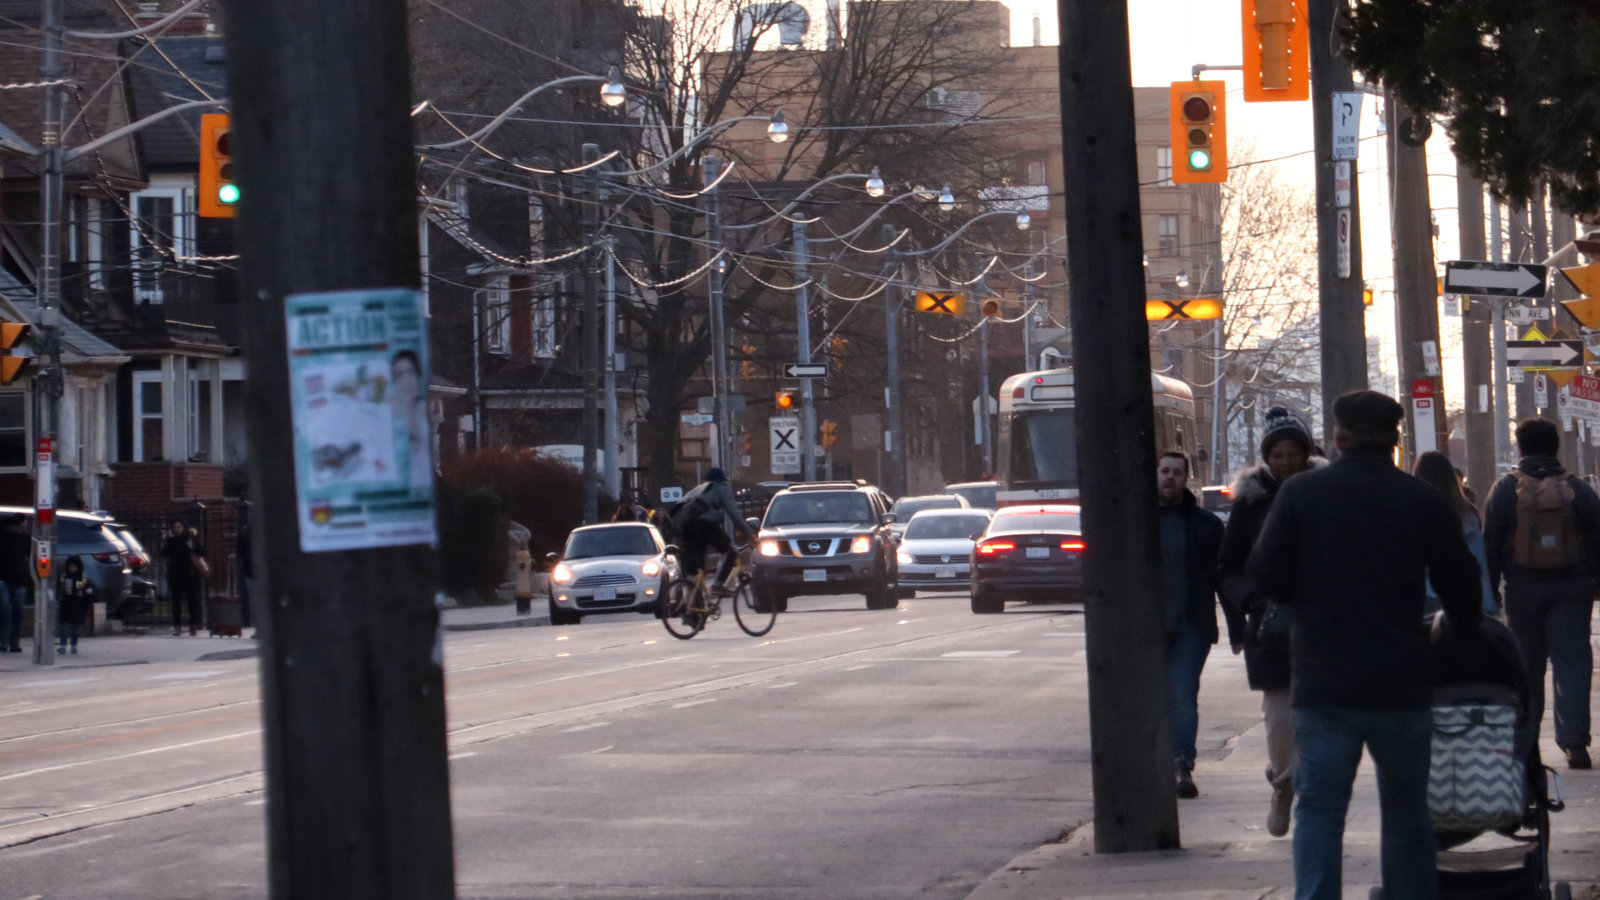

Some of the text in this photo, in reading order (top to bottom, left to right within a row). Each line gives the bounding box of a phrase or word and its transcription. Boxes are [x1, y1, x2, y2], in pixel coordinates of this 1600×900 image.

[1337, 136, 1355, 145] SNOW
[1528, 308, 1544, 319] AVE
[298, 313, 387, 344] ACTION
[1581, 377, 1598, 390] NO
[1040, 490, 1060, 499] 4104
